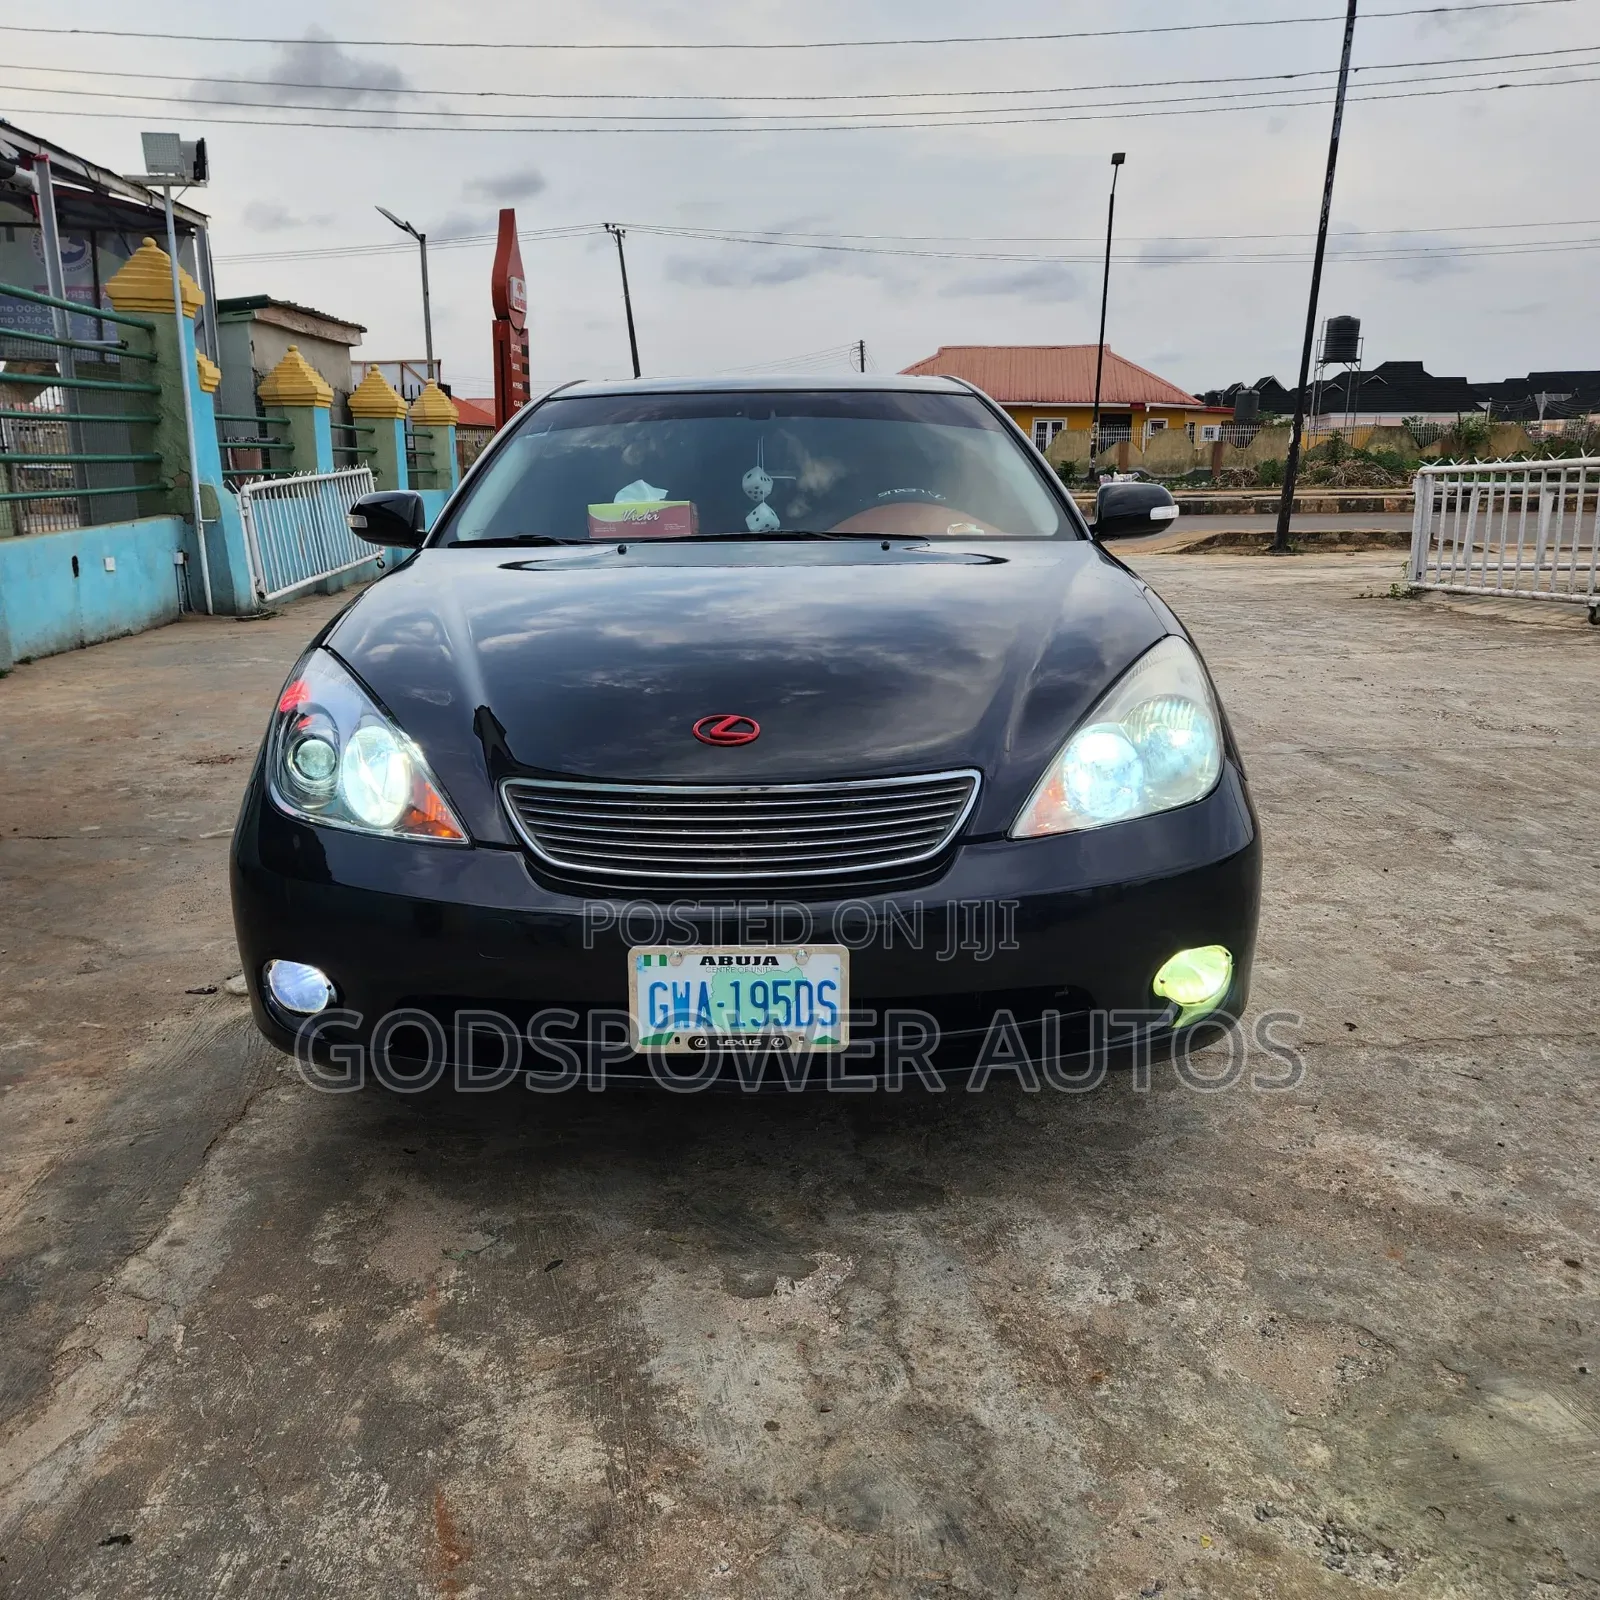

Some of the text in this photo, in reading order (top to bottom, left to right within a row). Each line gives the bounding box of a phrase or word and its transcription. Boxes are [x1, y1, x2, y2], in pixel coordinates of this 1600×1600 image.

[622, 508, 660, 522] Vicki
[700, 955, 779, 966] ABUJA
[705, 966, 774, 974] CENTRE OF UNITY
[648, 980, 838, 1028] GWA-195DS
[716, 1039, 762, 1047] LEXUS
